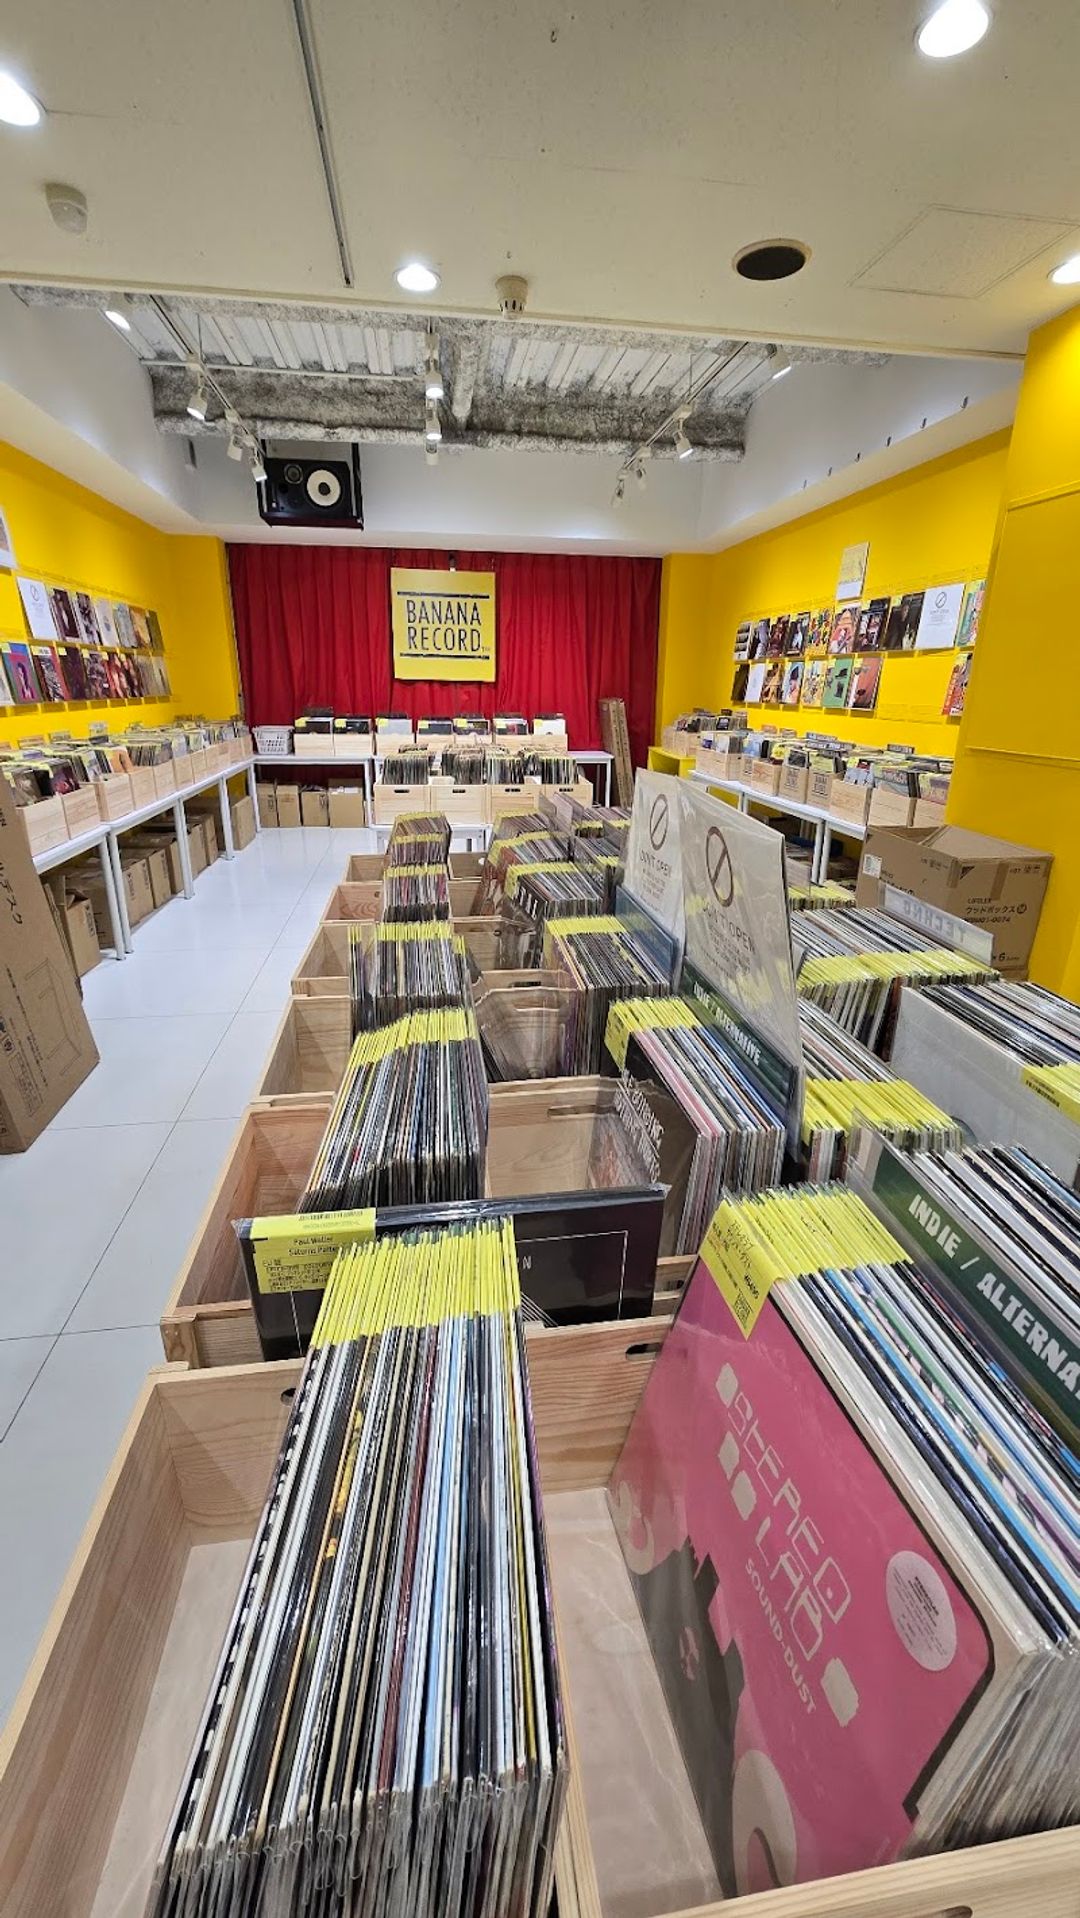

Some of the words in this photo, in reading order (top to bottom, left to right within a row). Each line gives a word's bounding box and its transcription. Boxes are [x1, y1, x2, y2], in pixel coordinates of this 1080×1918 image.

[406, 599, 482, 626] BANANA
[407, 626, 481, 652] RECORD
[908, 1194, 963, 1260] INDIE
[975, 1271, 1080, 1402] ALTERNA
[745, 1557, 817, 1715] SOUND-DUST
